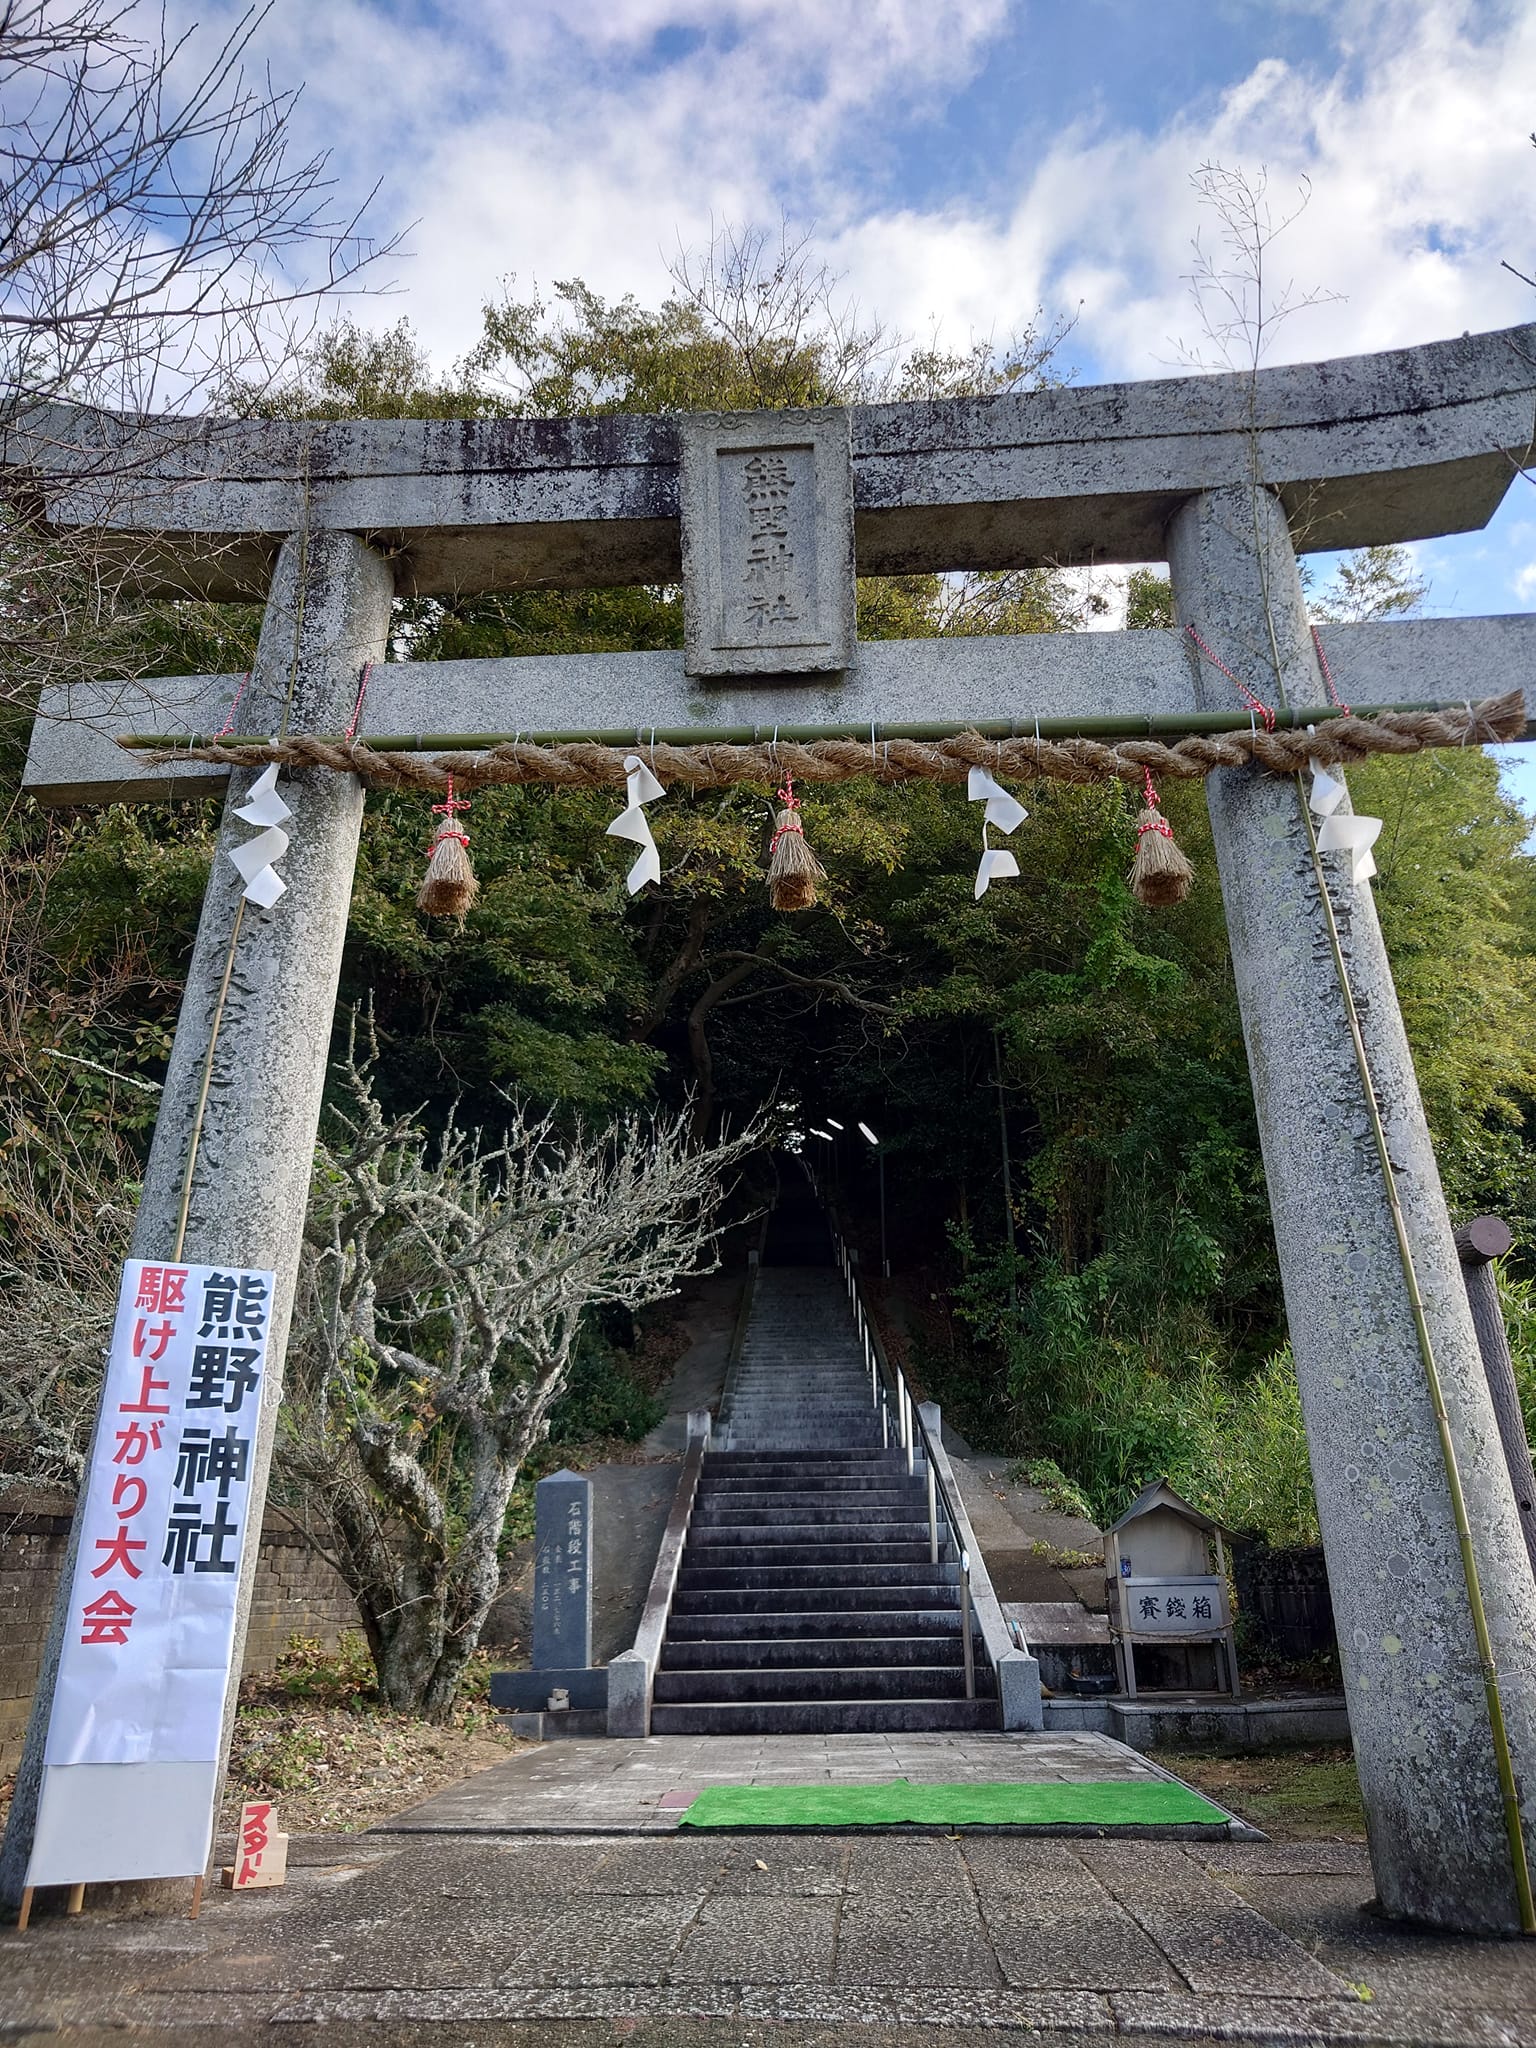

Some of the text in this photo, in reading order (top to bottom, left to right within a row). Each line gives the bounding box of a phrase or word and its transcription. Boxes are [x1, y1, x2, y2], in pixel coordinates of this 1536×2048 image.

[81, 1266, 188, 1647] 駆け上がり大会
[162, 1270, 269, 1577] 熊野神社
[567, 1501, 583, 1595] 石階段工事
[237, 1804, 271, 1886] スタート
